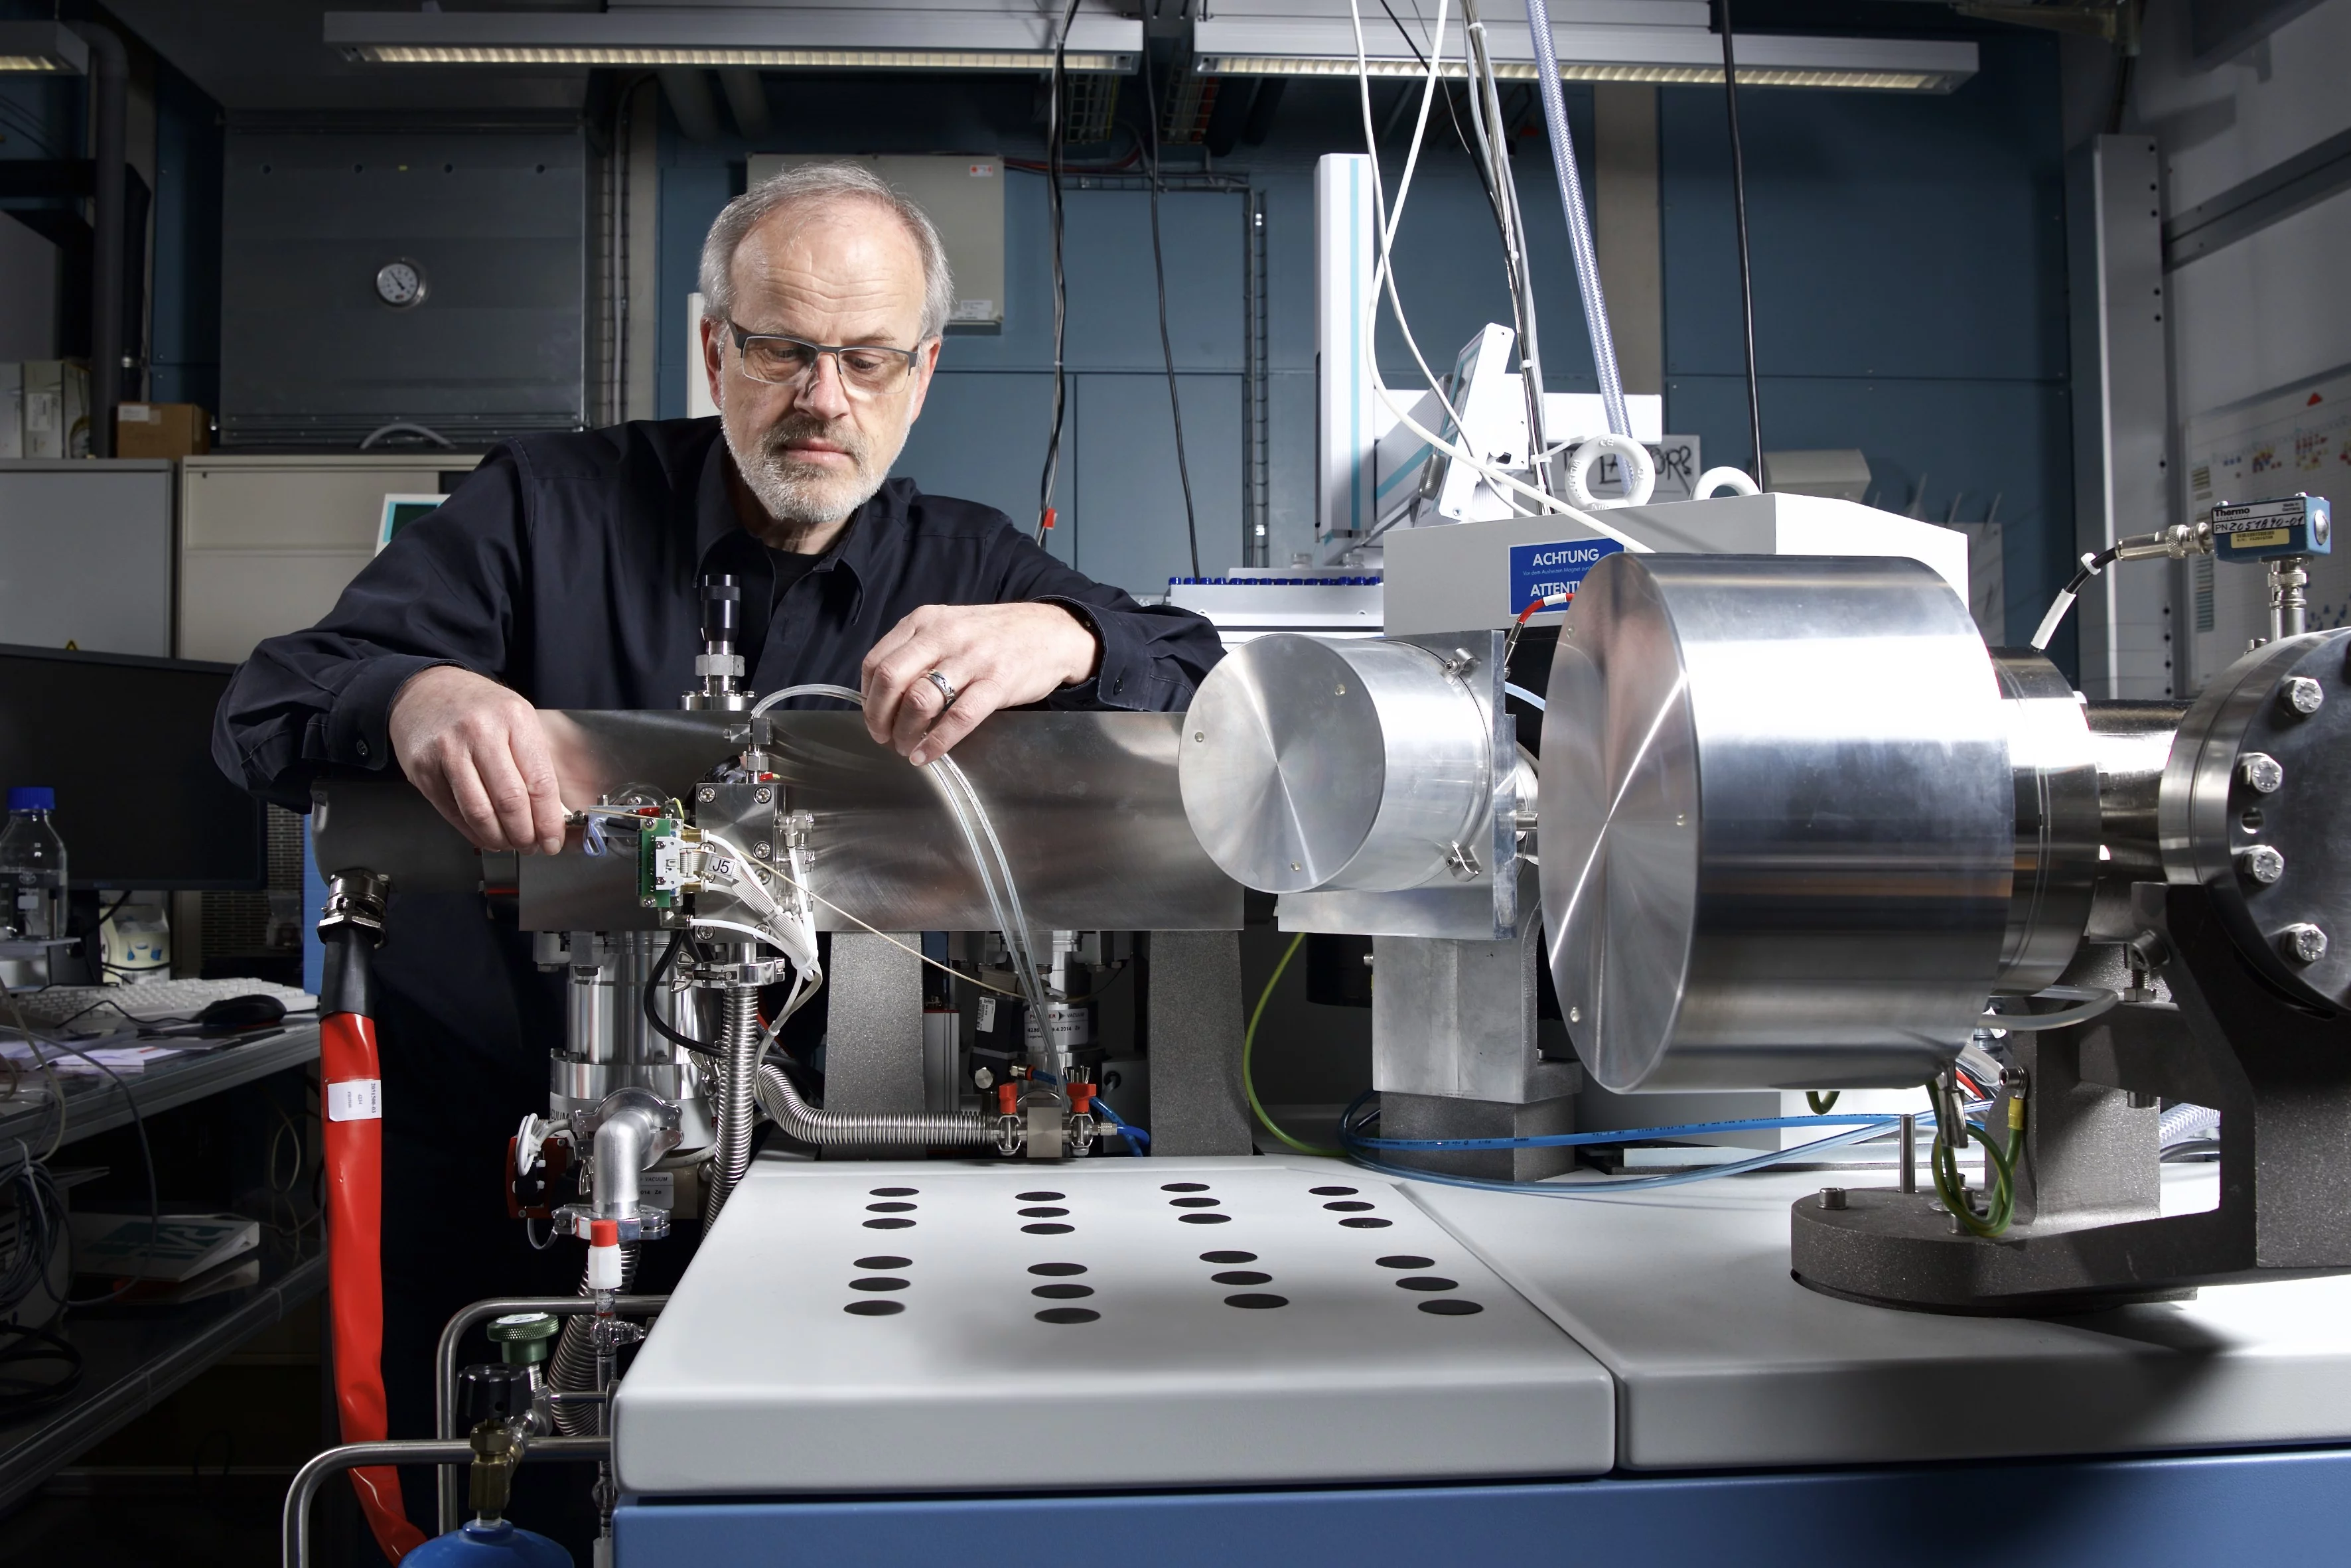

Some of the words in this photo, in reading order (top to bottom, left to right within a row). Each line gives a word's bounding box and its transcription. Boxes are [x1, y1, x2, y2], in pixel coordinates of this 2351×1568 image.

[2214, 508, 2249, 517] Thermo
[1532, 548, 1599, 566] ACHTUNG
[712, 859, 730, 873] J5
